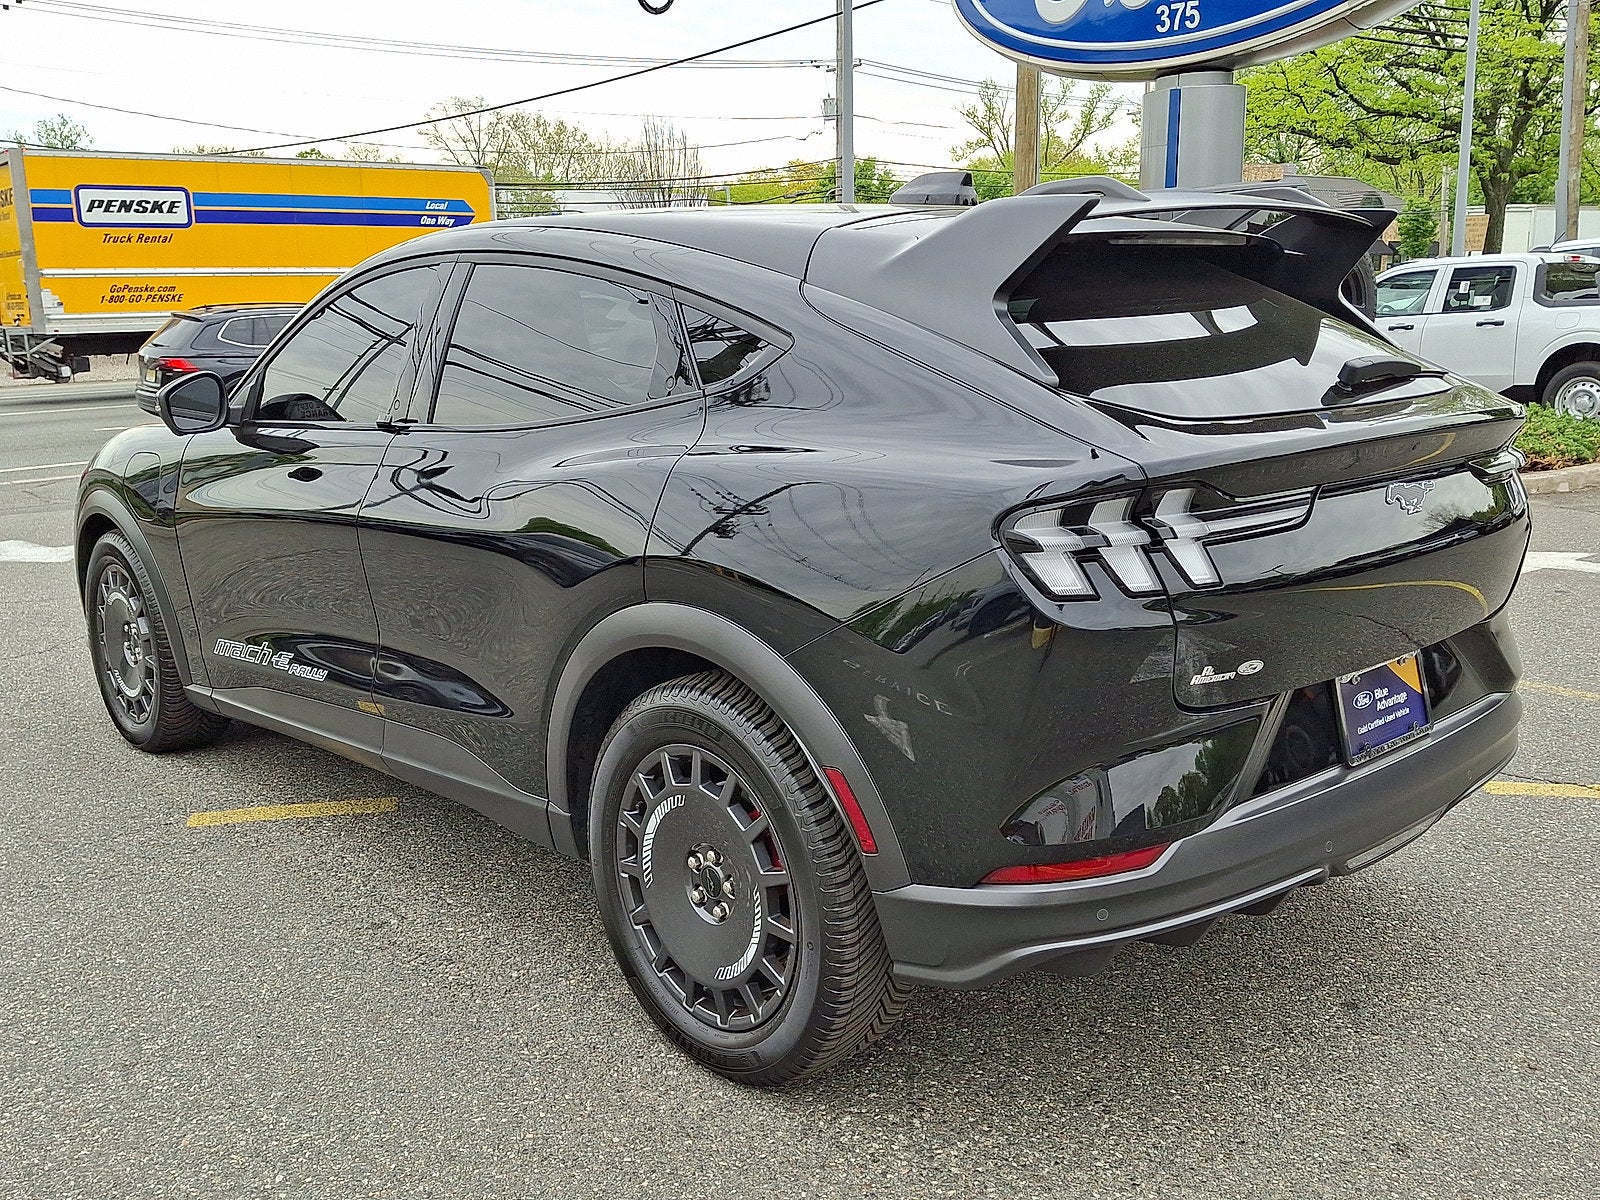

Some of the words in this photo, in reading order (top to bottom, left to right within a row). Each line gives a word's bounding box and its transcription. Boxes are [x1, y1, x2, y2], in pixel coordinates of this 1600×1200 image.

[1155, 1, 1201, 33] 375
[86, 199, 182, 214] PENSKE
[425, 201, 448, 209] Local
[420, 215, 437, 225] One
[437, 216, 456, 228] Way
[102, 233, 134, 243] Truck
[136, 233, 173, 243] Rental
[109, 284, 177, 294] GoPenske.com
[100, 293, 184, 304] 1-800-GO-PENSKE
[288, 664, 328, 682] RALLY
[1374, 687, 1389, 700] Blue
[1376, 691, 1408, 712] Advantage
[1358, 725, 1368, 735] Gold
[1367, 716, 1385, 731] Certified
[1384, 712, 1396, 723] Used
[1395, 706, 1410, 719] Vehicle
